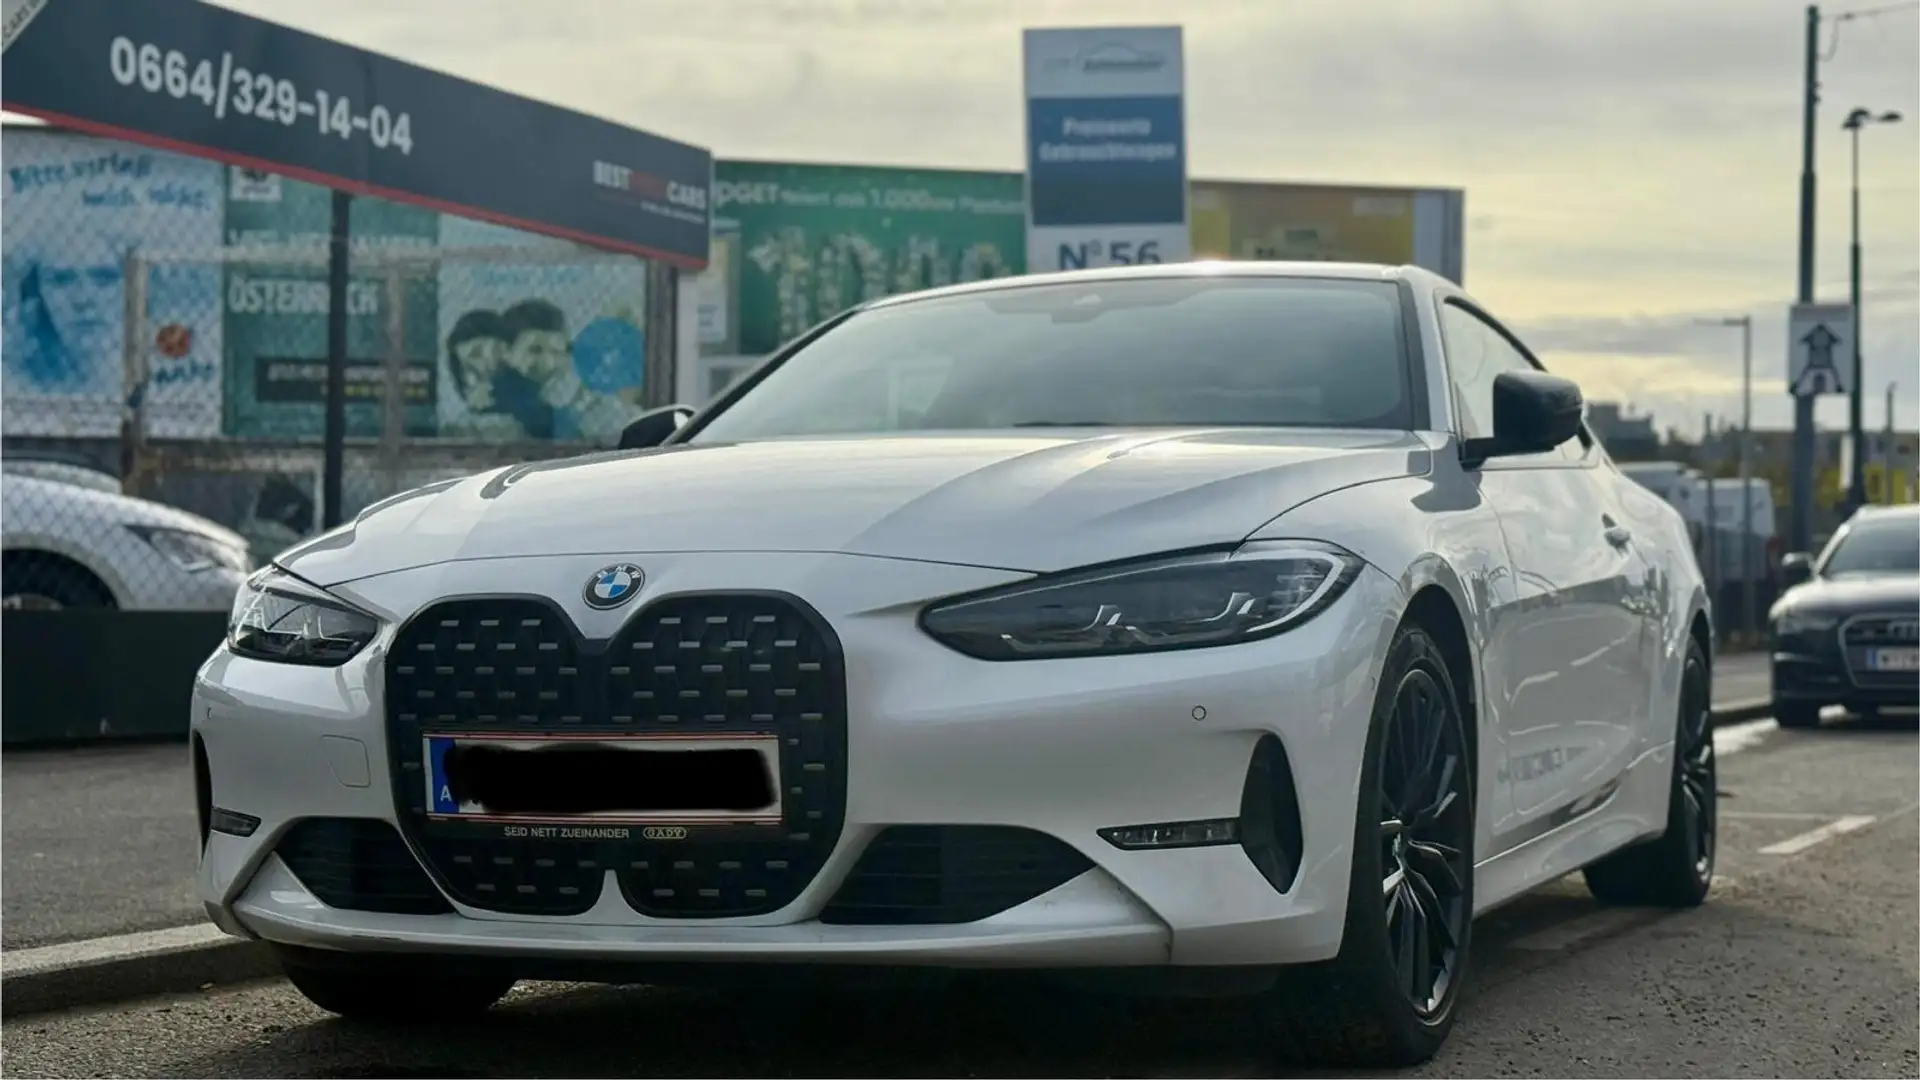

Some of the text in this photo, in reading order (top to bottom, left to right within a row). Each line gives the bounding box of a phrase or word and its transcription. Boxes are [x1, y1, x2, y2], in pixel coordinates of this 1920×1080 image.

[110, 36, 413, 155] 0664/329-14-04
[593, 160, 633, 191] BEST
[667, 180, 705, 210] CARS
[440, 785, 451, 802] A
[504, 826, 528, 837] SEID
[531, 827, 558, 838] NETT
[560, 827, 630, 839] ZUEINANDER
